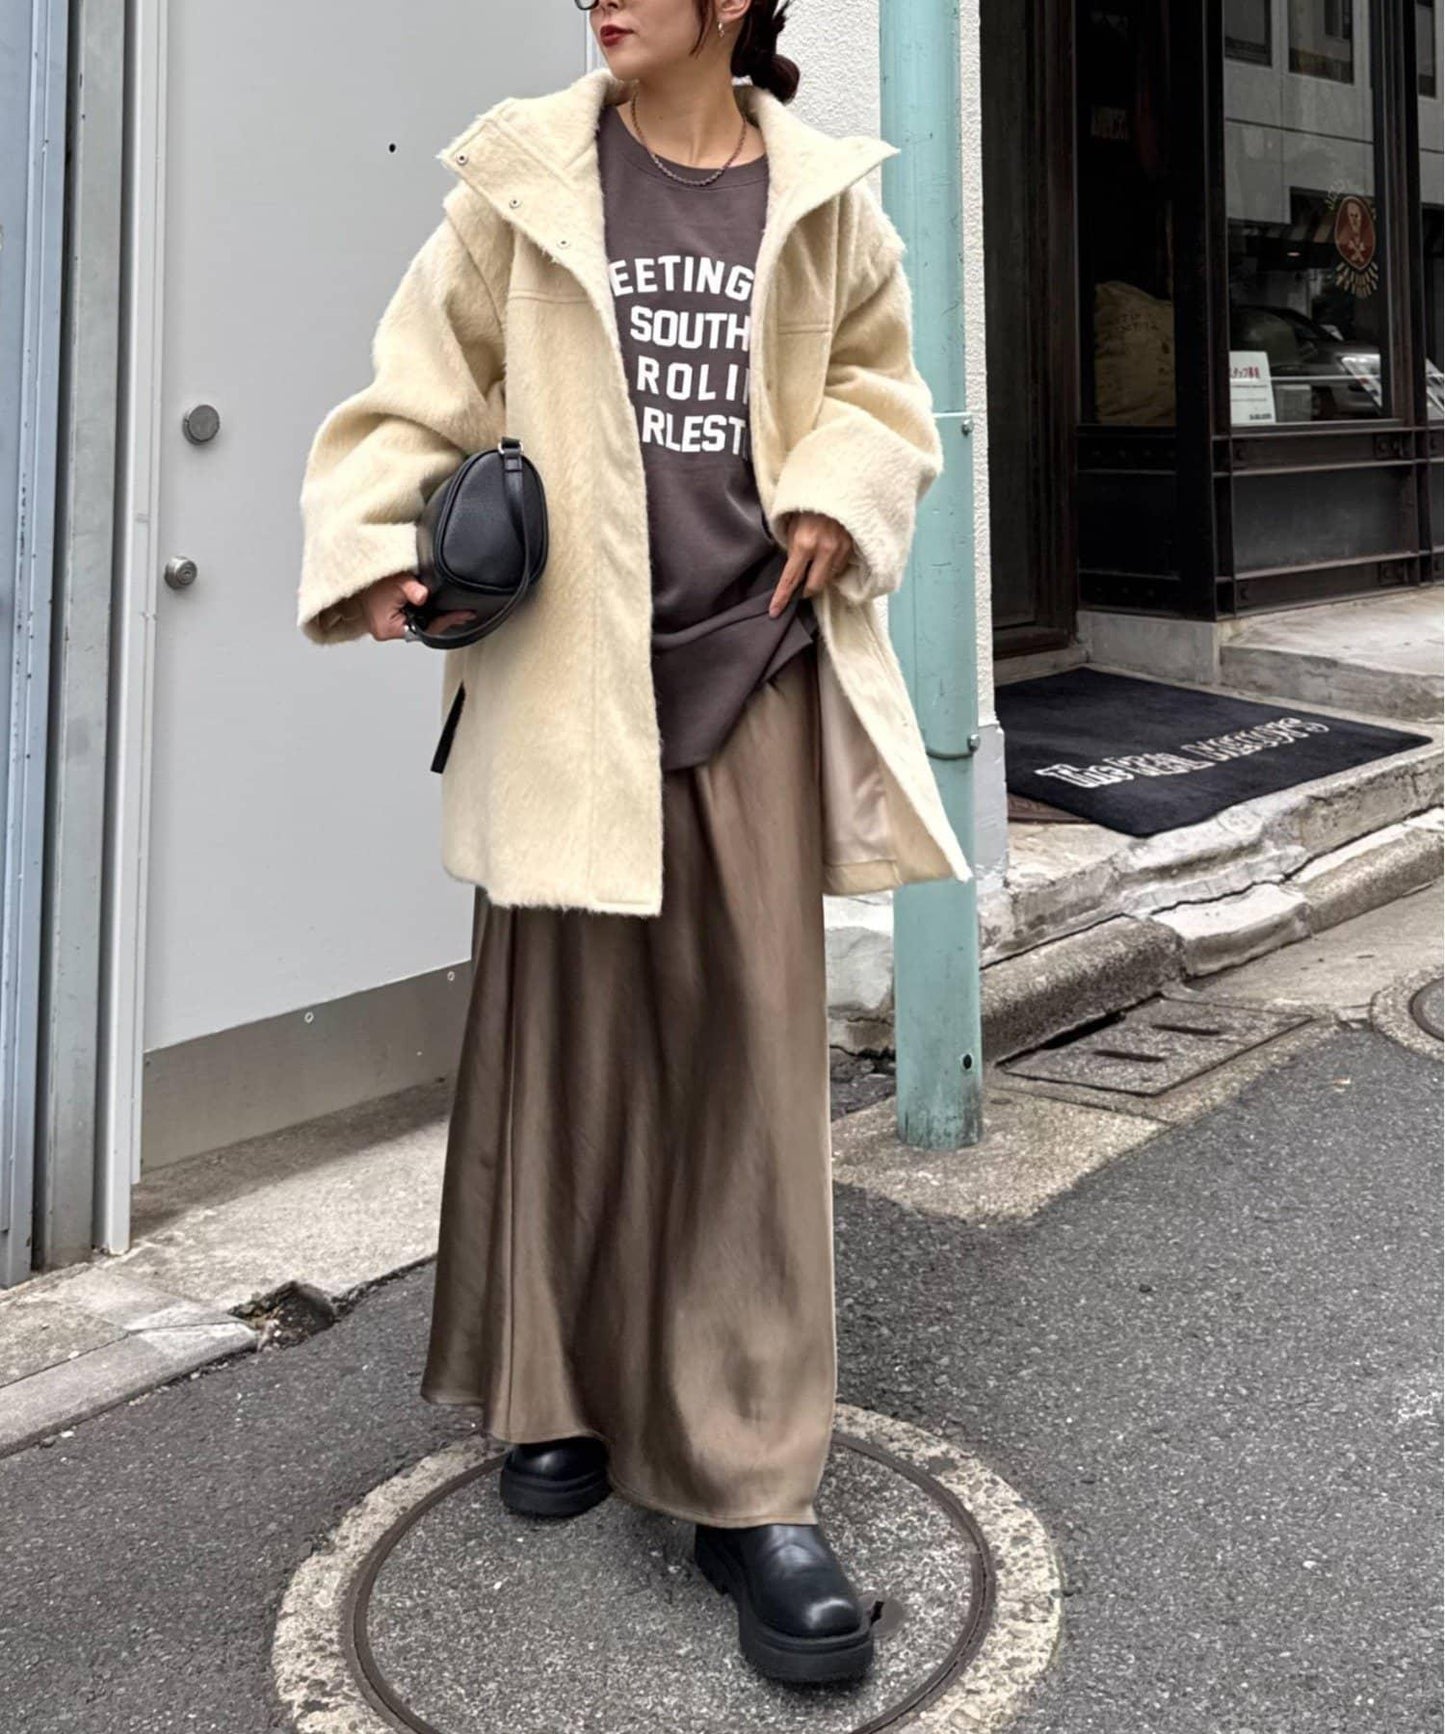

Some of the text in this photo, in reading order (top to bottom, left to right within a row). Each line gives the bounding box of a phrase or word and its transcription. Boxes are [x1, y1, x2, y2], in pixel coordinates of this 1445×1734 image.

[609, 255, 754, 301] EETING
[630, 305, 750, 351] SOUTH
[637, 355, 749, 404] ROLI
[642, 406, 747, 457] RLEST
